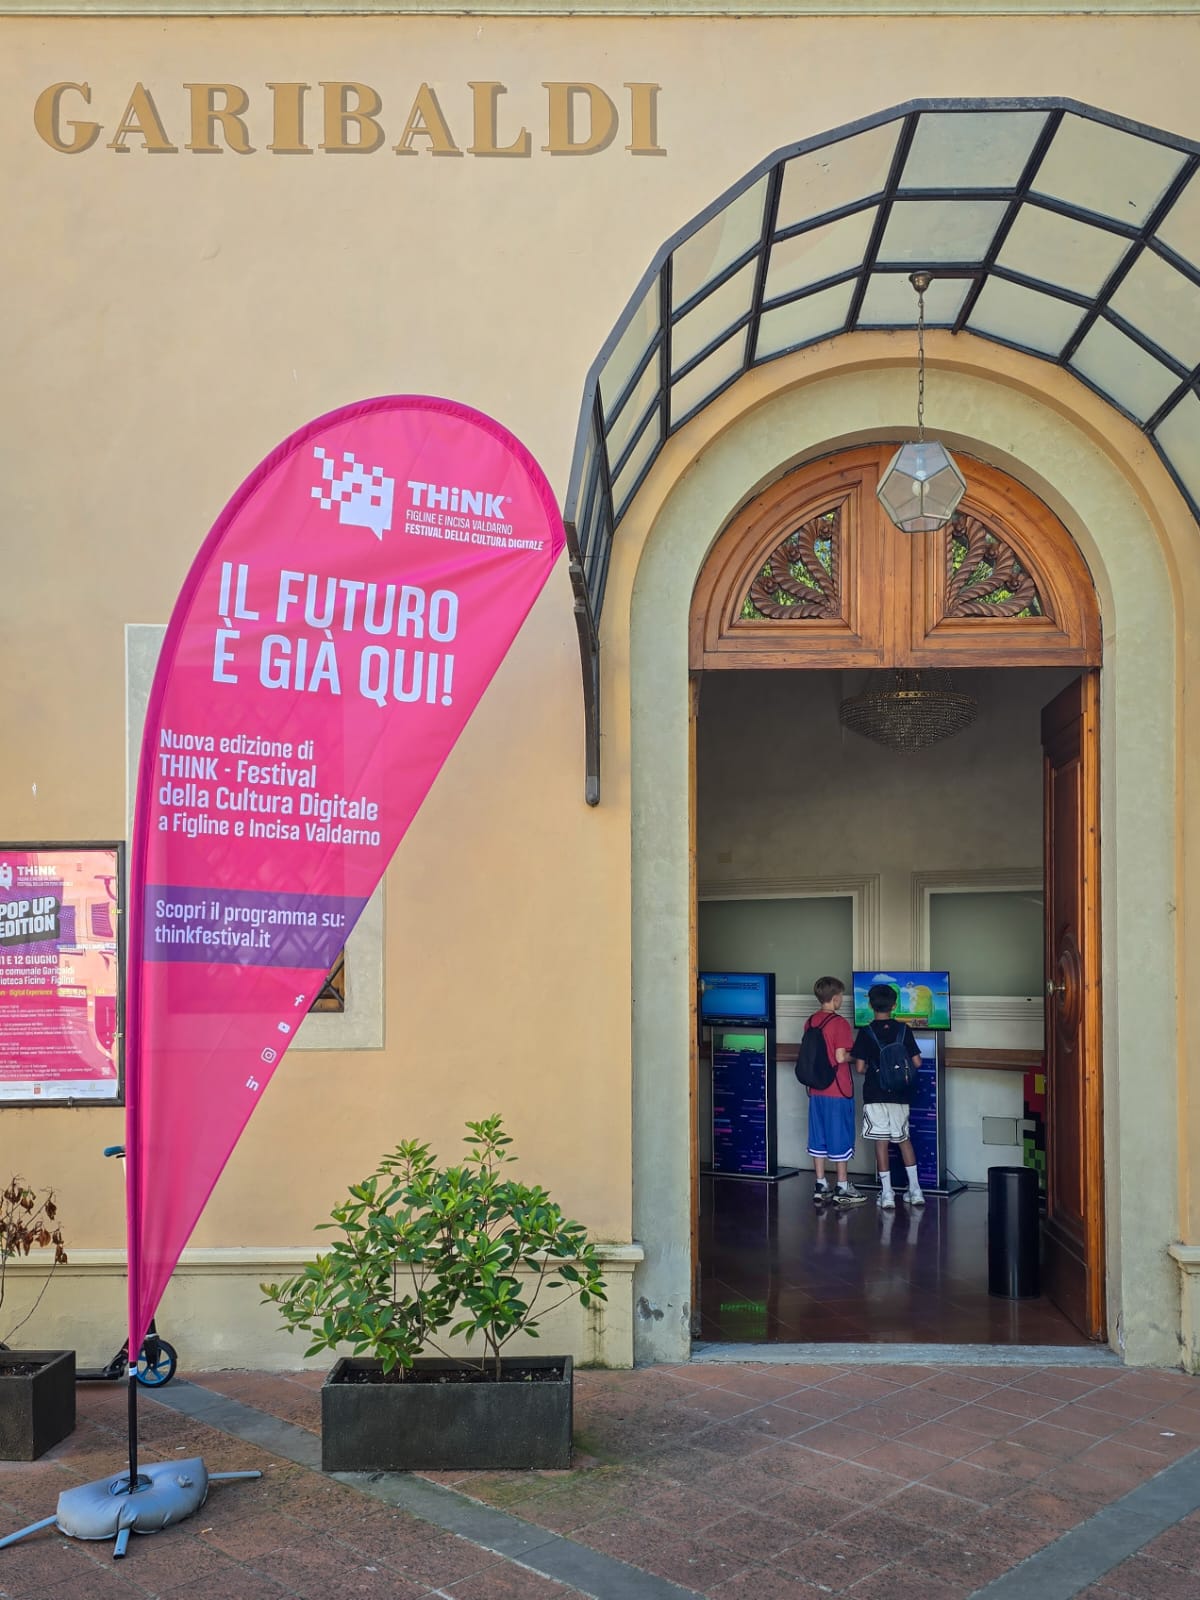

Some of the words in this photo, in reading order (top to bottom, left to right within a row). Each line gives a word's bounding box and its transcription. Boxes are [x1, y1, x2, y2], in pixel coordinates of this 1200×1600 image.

[34, 81, 667, 156] GARIBALDI
[405, 523, 443, 539] FESTIVAL
[444, 529, 469, 543] DELLA
[471, 533, 507, 548] CULTURA
[508, 539, 544, 551] DIGITALE
[406, 510, 437, 524] FIGLINE
[438, 515, 443, 526] E
[444, 515, 470, 529] INCISA
[472, 520, 513, 536] VALDARNO
[218, 562, 260, 621] IL
[276, 570, 459, 643] FUTURO
[212, 617, 240, 684] È
[259, 629, 341, 695] GIÀ
[359, 645, 455, 708] QUI!
[160, 729, 214, 752] Nuova
[219, 734, 293, 759] edizione
[297, 740, 315, 760] di
[160, 754, 219, 780] THINK
[237, 760, 317, 788] Festival
[159, 782, 209, 808] della
[216, 787, 293, 814] Cultura
[299, 793, 379, 823] Digitale
[158, 814, 168, 832] a
[173, 813, 230, 838] Figline
[234, 820, 245, 836] e
[249, 819, 300, 841] Incisa
[305, 823, 381, 846] Valdarno
[0, 900, 30, 920] POP
[32, 896, 56, 915] UP
[156, 900, 206, 922] Scopri
[211, 902, 220, 920] il
[224, 906, 317, 927] programma
[321, 912, 345, 927] su:
[0, 914, 56, 938] EDITION
[154, 924, 271, 948] thinkfestival.it
[7, 955, 12, 965] E
[14, 955, 24, 965] 12
[25, 955, 58, 965] GIUGNO
